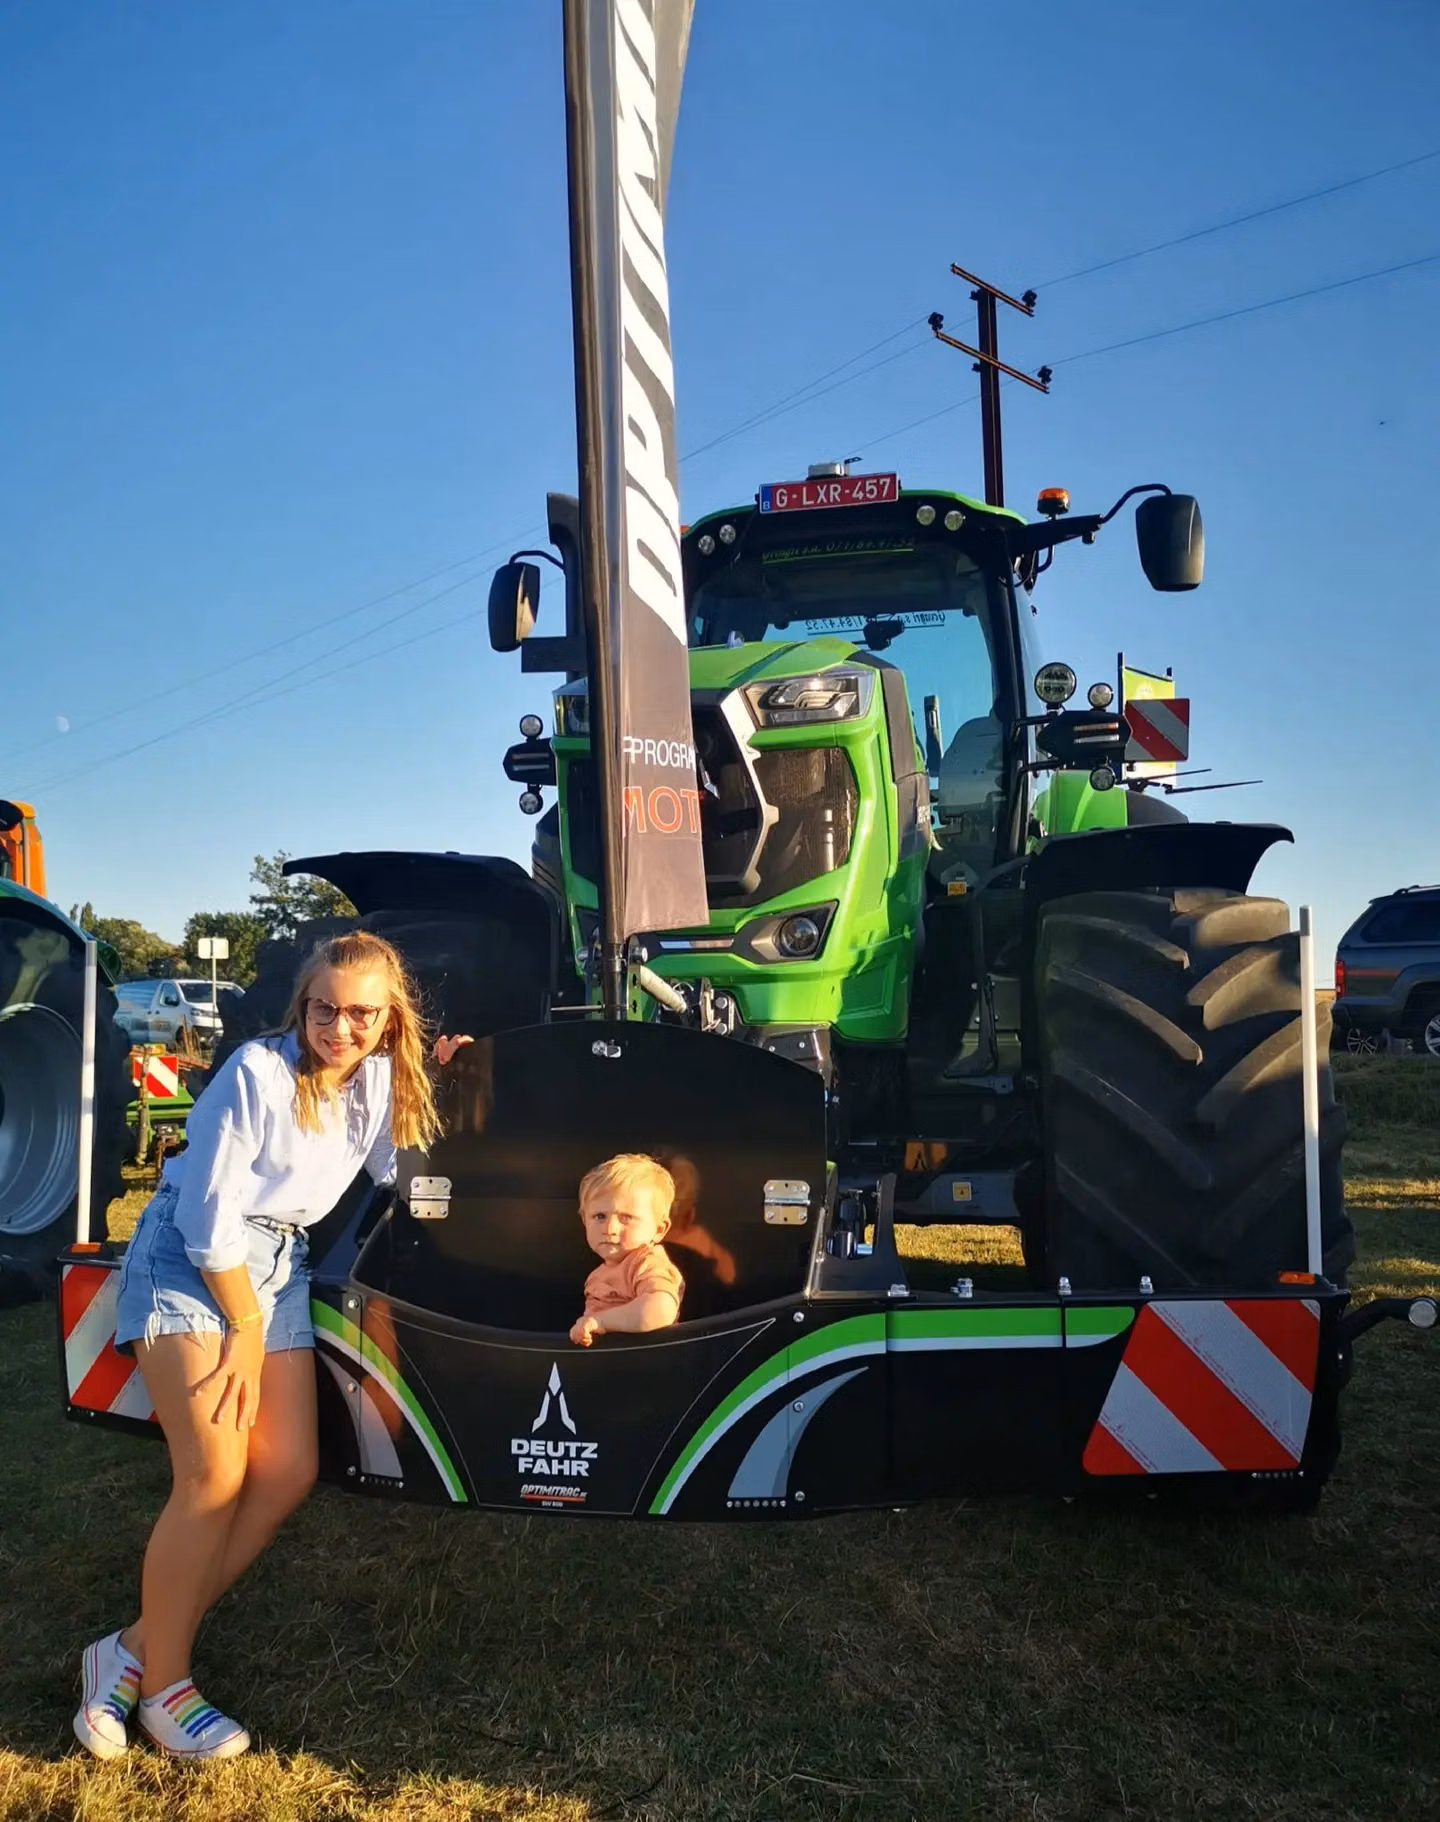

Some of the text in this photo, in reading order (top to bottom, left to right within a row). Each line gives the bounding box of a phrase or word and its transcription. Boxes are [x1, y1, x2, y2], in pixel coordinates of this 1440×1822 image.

[775, 477, 891, 508] G-LXR-457
[510, 1438, 599, 1459] DEUTZ
[518, 1457, 590, 1477] FAHR
